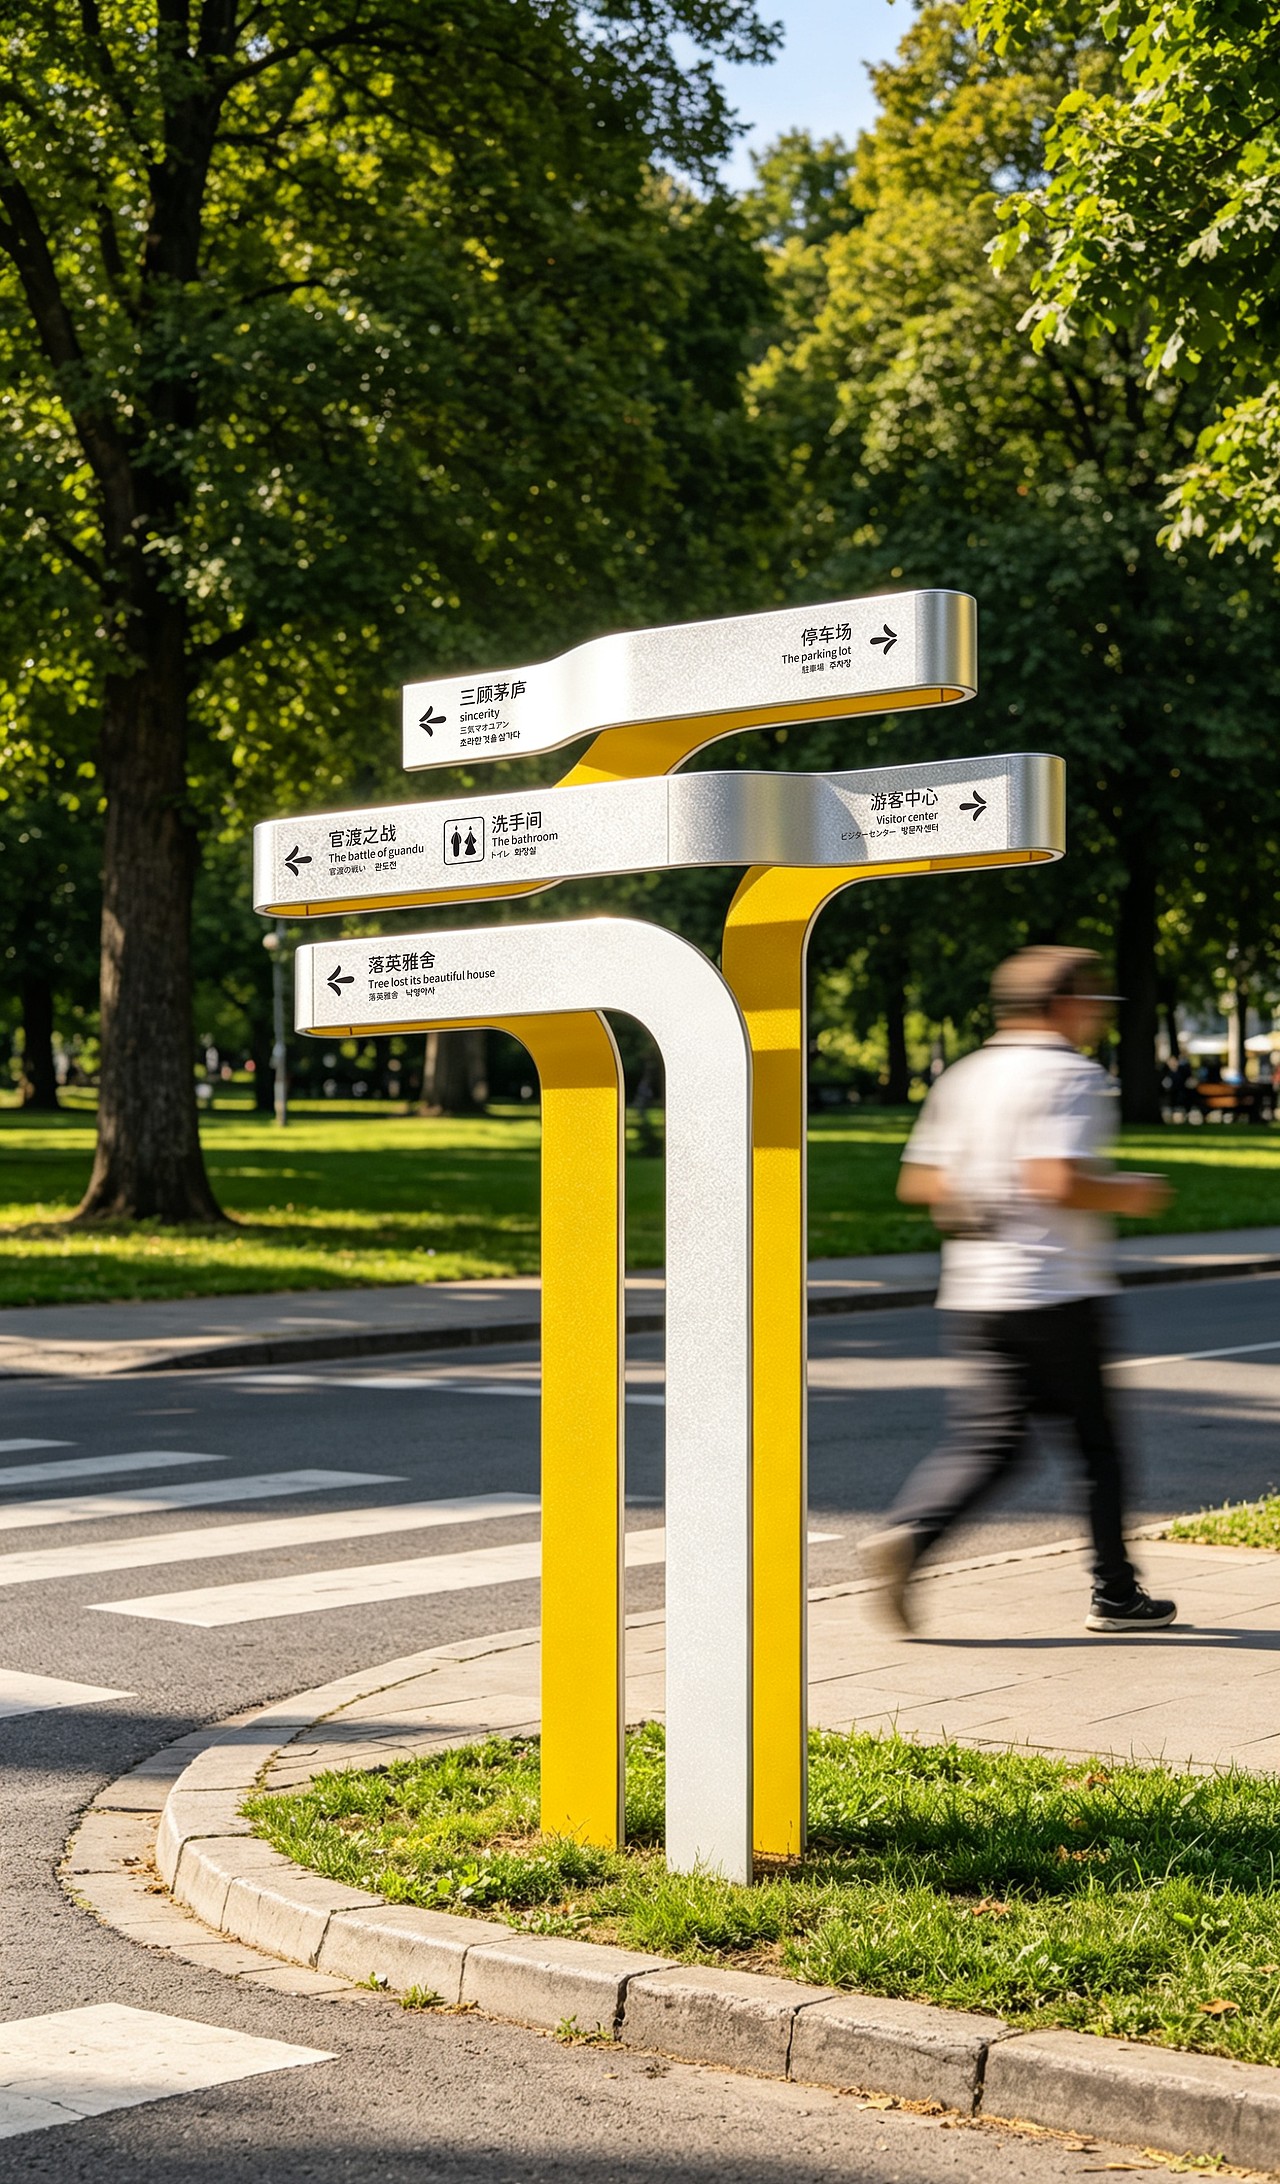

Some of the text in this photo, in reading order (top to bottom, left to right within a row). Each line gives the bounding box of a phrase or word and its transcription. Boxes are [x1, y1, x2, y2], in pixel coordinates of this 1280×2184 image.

[801, 623, 852, 647] 停车场
[782, 646, 852, 664] The parking lot
[802, 663, 825, 674] 駐車場
[829, 659, 852, 669] 주차장
[460, 680, 527, 706] 三顾茅庐
[460, 708, 500, 722] sincerity
[870, 788, 938, 811] 游客中心
[492, 811, 541, 833] 洗手间
[876, 812, 939, 825] Visitor center
[329, 824, 396, 848] 官渡之战
[492, 832, 558, 847] The bathroom
[841, 829, 896, 840] ビジターセンター
[329, 844, 424, 863] The battle of guandu
[491, 850, 510, 859] トイレ
[514, 846, 537, 856] 화장실
[375, 861, 397, 871] 관도전
[368, 951, 436, 974] 落英雅舍
[368, 970, 496, 989] Tree lost its beautiful house
